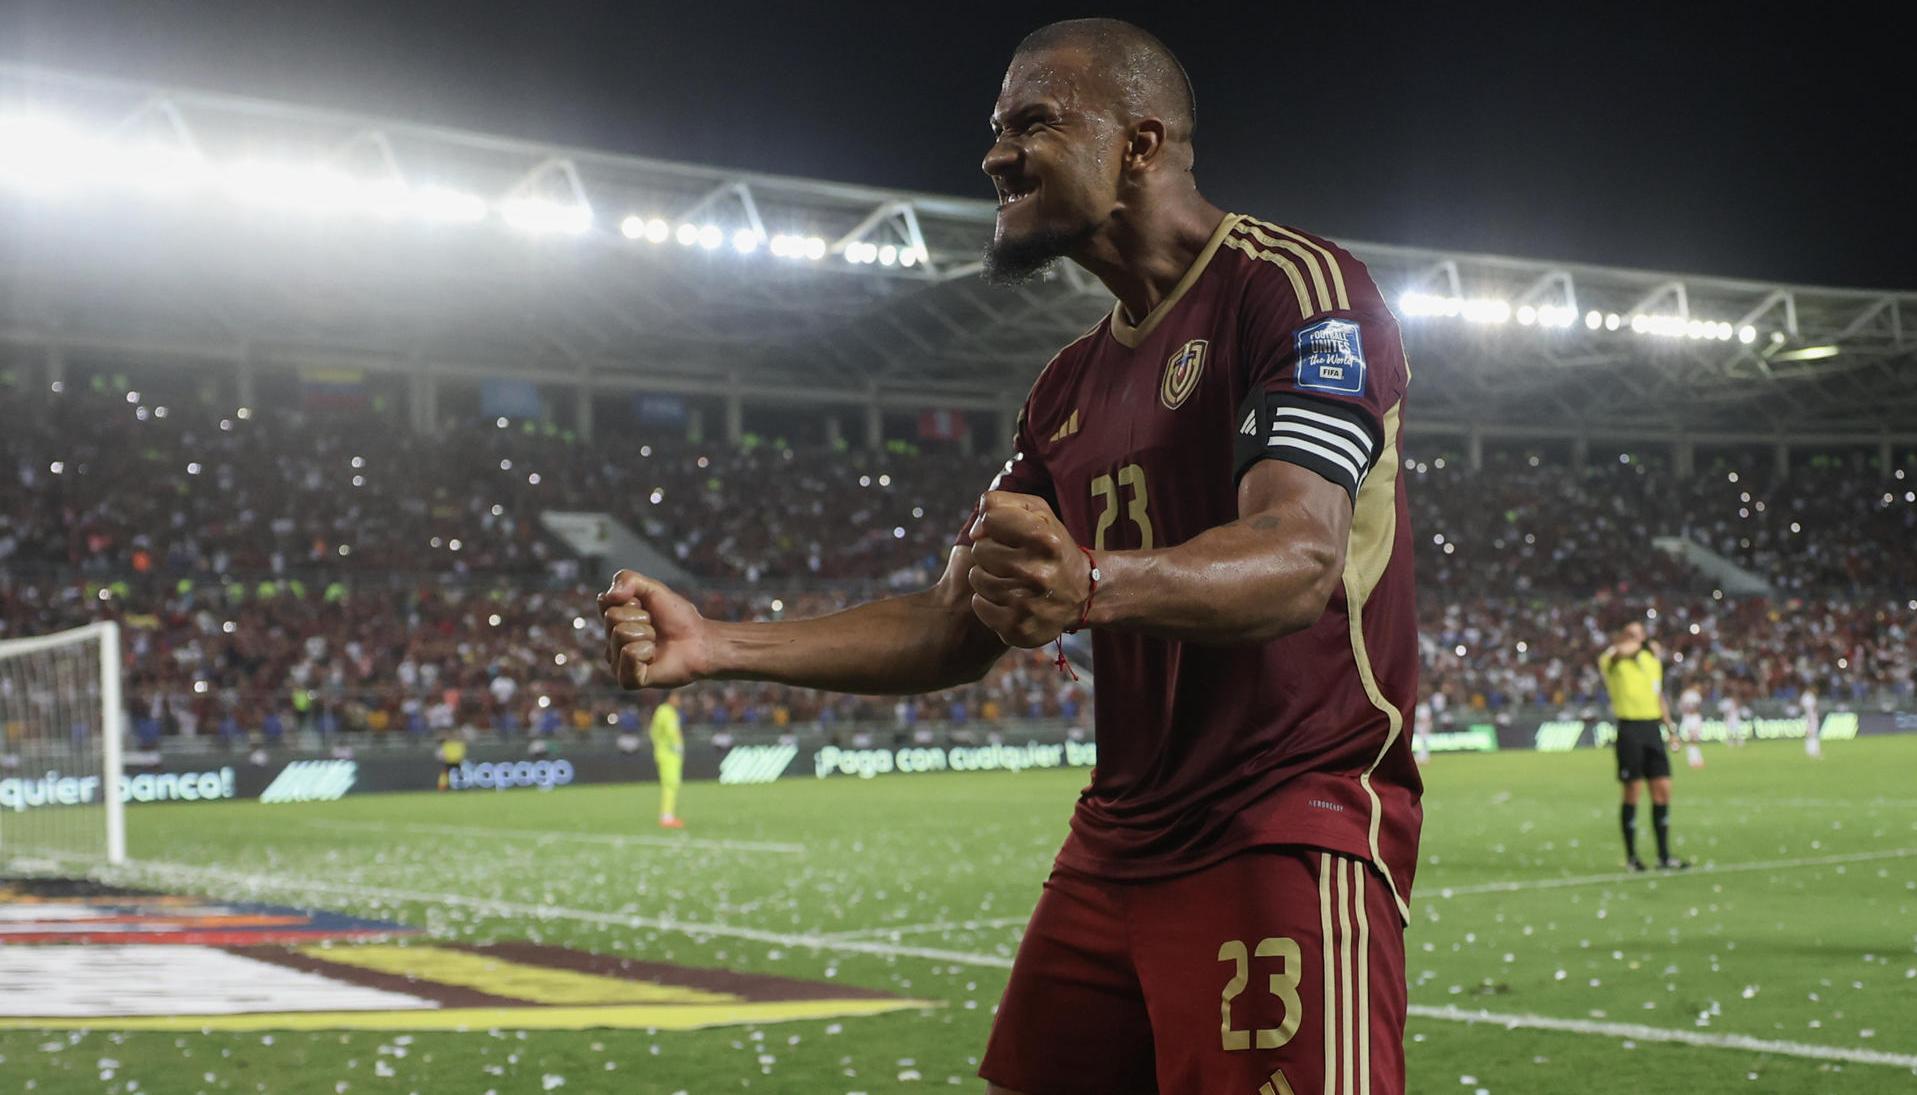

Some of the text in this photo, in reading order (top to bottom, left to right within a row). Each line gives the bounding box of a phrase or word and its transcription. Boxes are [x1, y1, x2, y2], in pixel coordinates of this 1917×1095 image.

[1310, 330, 1349, 341] FOOTBALL
[1311, 339, 1351, 354] UNITES
[1309, 354, 1326, 366] the
[1322, 368, 1340, 377] FIFA
[1091, 464, 1153, 550] 23
[896, 747, 947, 772] con
[948, 740, 1064, 773] cualquier
[0, 770, 99, 812] quier
[1217, 937, 1302, 1051] 23
